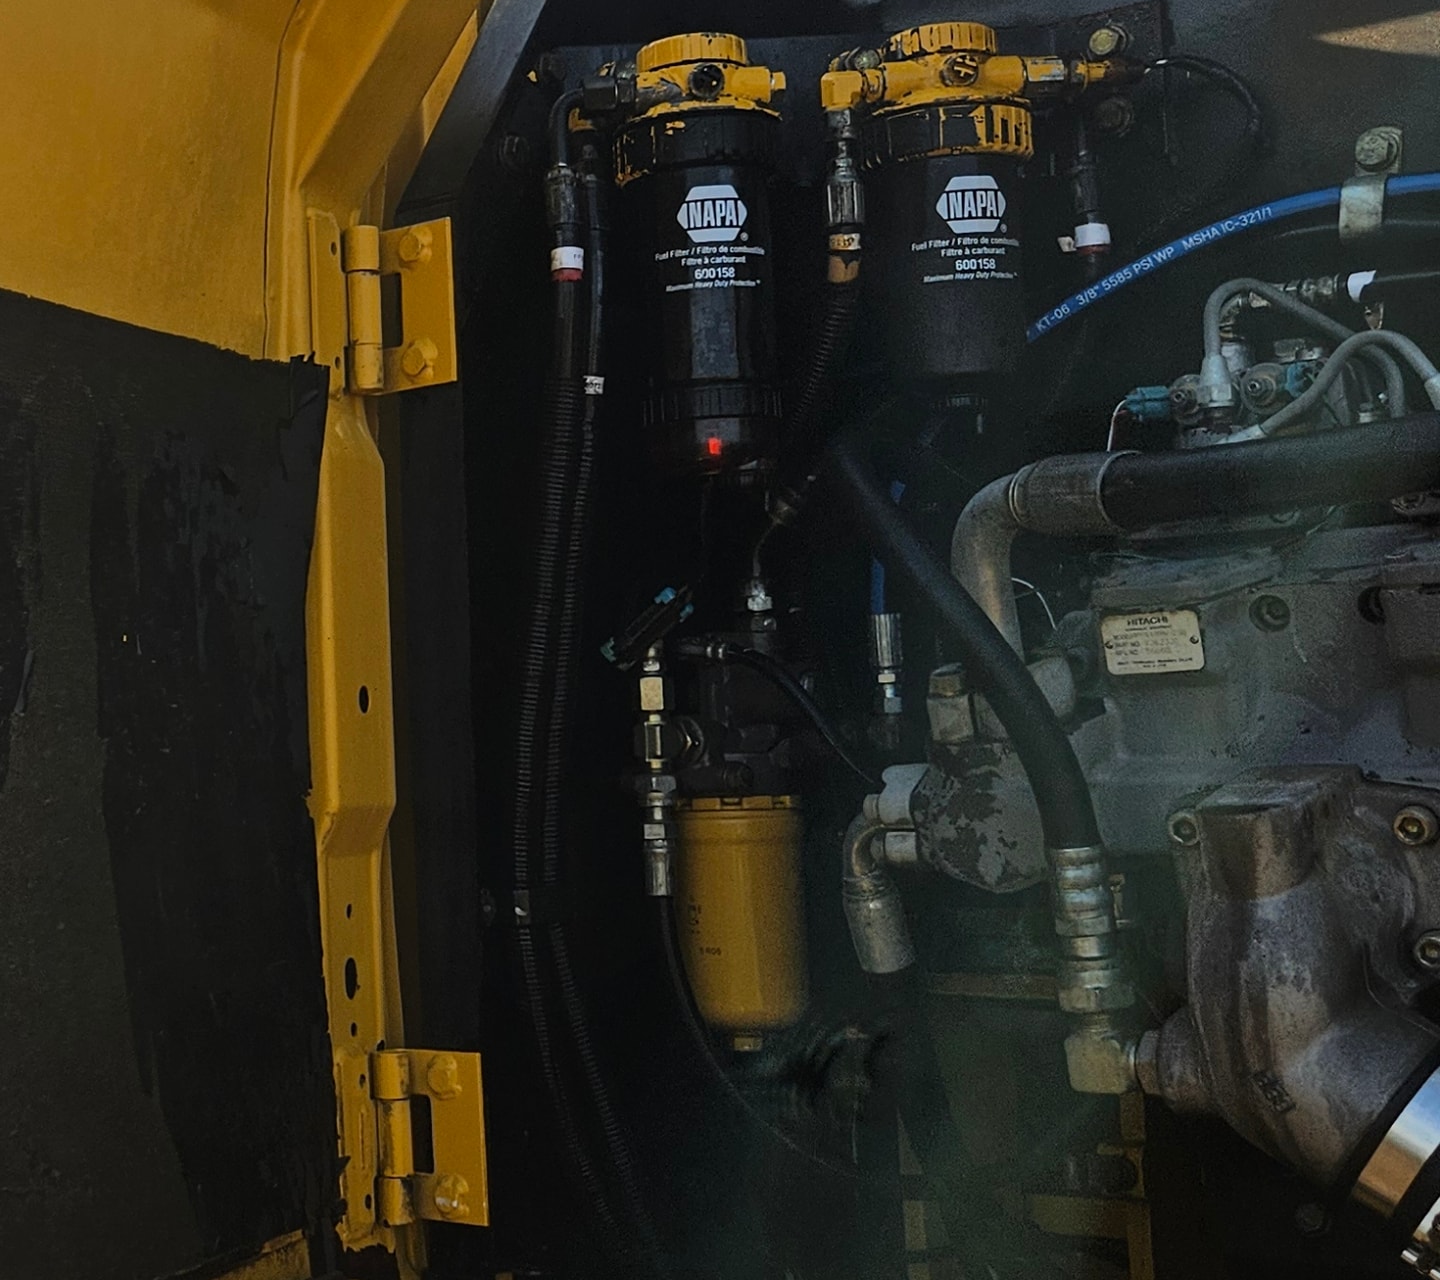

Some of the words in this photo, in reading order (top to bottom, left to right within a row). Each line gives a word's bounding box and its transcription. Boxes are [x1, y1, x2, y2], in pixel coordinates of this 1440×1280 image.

[948, 191, 997, 219] NAPA
[688, 200, 737, 228] NAPA
[911, 241, 927, 251] Fuel
[928, 239, 950, 248] Filter
[957, 237, 977, 245] Filtro
[979, 236, 989, 244] de
[655, 251, 669, 260] Fuel
[670, 248, 689, 258] Filter
[696, 246, 717, 254] Filtro
[719, 245, 728, 253] de
[941, 249, 962, 257] Filtre
[971, 246, 1006, 255] carburant
[681, 258, 702, 266] Filtre
[710, 255, 746, 264] carburant
[955, 258, 996, 271] 600158
[694, 267, 735, 279] 600158
[976, 271, 990, 279] Duty
[1035, 304, 1071, 333] KT-06
[1101, 268, 1133, 292] 5585
[1132, 257, 1154, 275] PSI
[1153, 246, 1176, 265] WP
[1181, 226, 1221, 251] MSHA
[1220, 206, 1273, 235] IC-321/1
[1127, 616, 1169, 626] HITACHI
